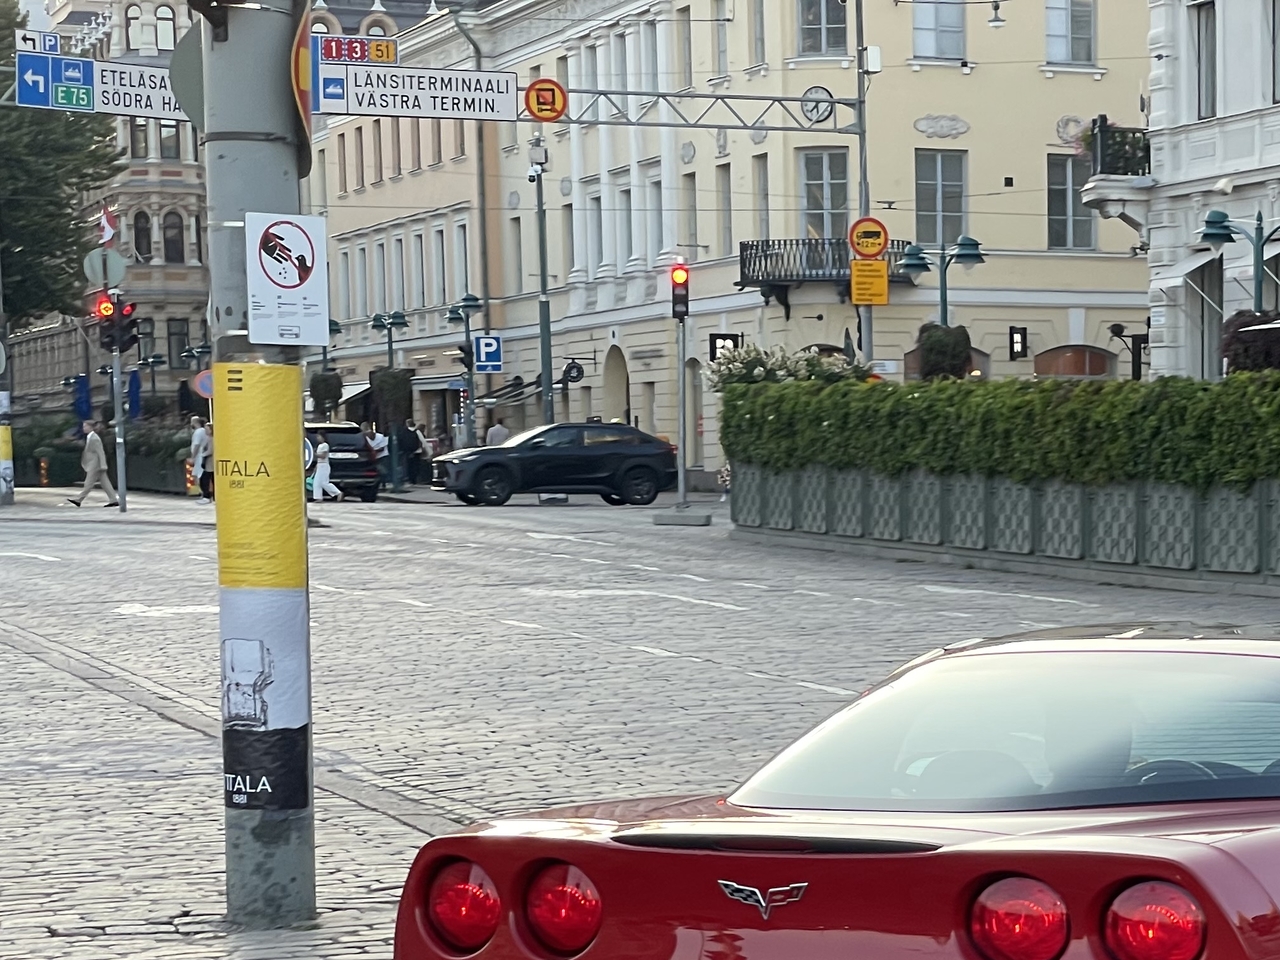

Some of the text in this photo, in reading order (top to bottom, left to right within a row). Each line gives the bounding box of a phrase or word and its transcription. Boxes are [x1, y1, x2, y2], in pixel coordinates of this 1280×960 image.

[45, 36, 55, 51] P
[330, 41, 390, 60] 1 3 51
[101, 69, 170, 91] ETELÄSA
[354, 70, 509, 94] LÄNSITERMINAALI
[57, 87, 88, 105] E 75
[101, 88, 153, 110] SÖDRA
[355, 90, 500, 113] VÄSTRA TERMIN.
[480, 338, 498, 361] P
